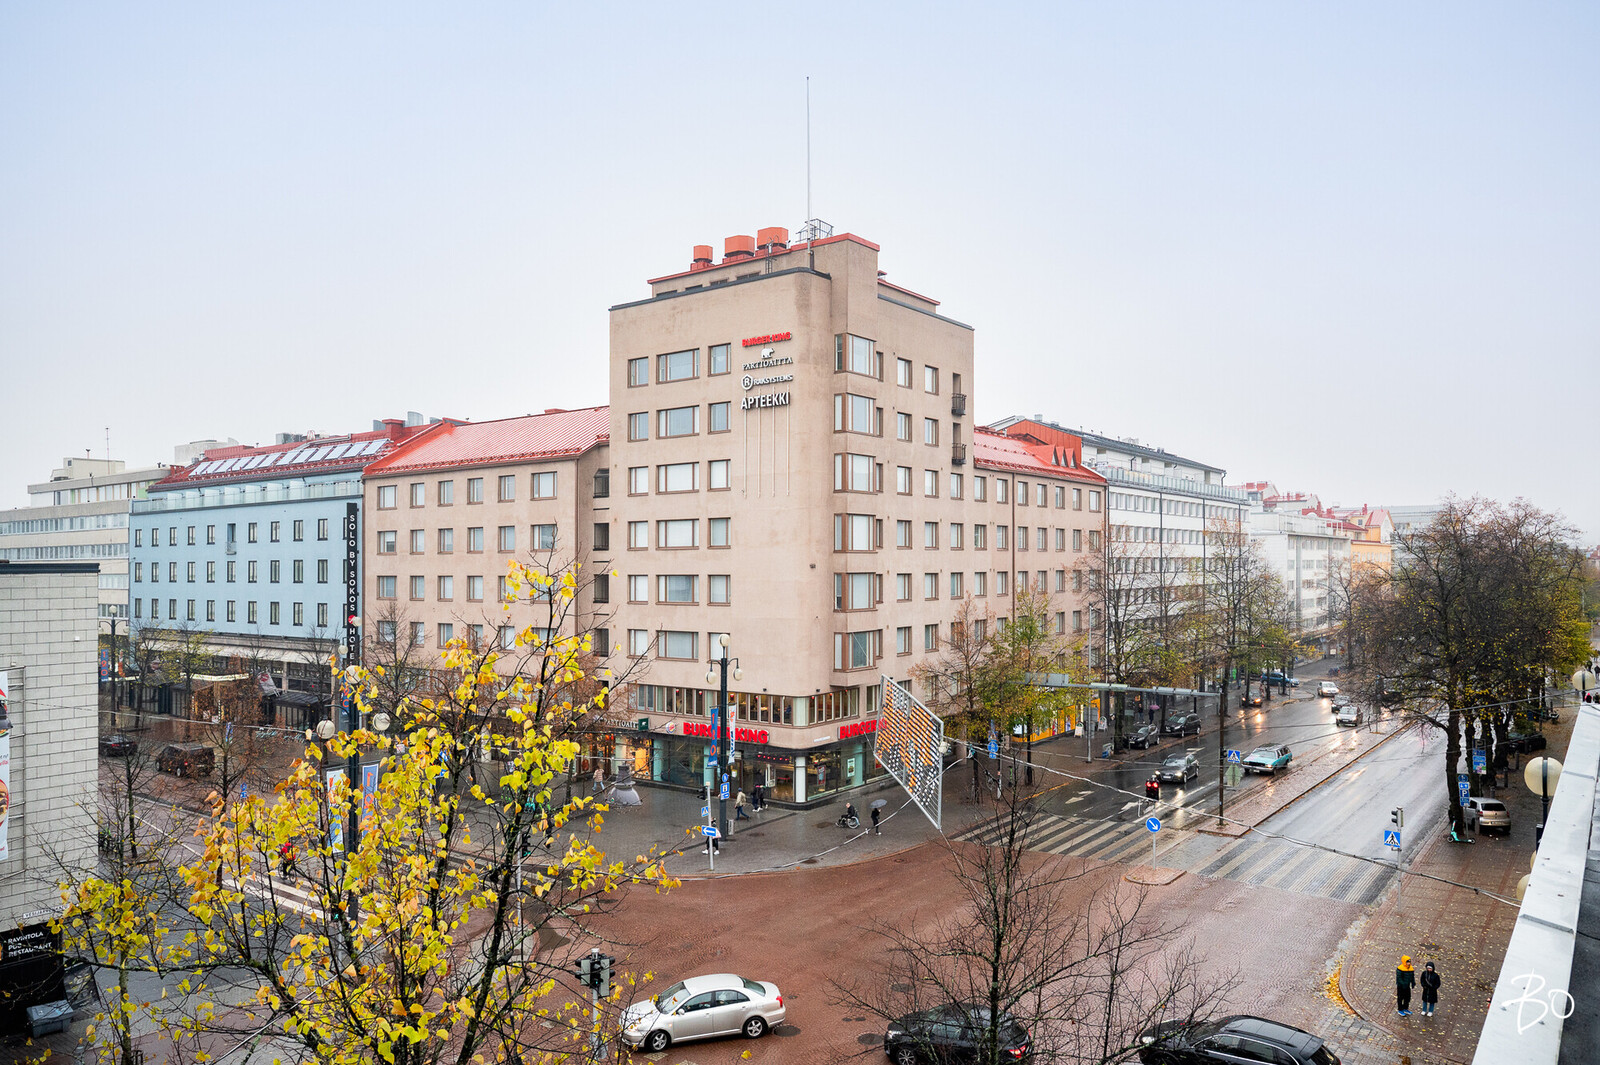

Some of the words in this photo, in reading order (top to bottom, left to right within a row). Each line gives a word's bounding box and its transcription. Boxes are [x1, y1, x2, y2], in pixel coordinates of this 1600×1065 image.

[742, 335, 771, 347] BURGER
[772, 332, 791, 342] KING
[741, 392, 790, 409] APTEEKKI
[349, 551, 356, 567] BY
[735, 727, 769, 744] KING
[839, 718, 877, 739] BURGER
[8, 931, 43, 944] RAVINTOLA
